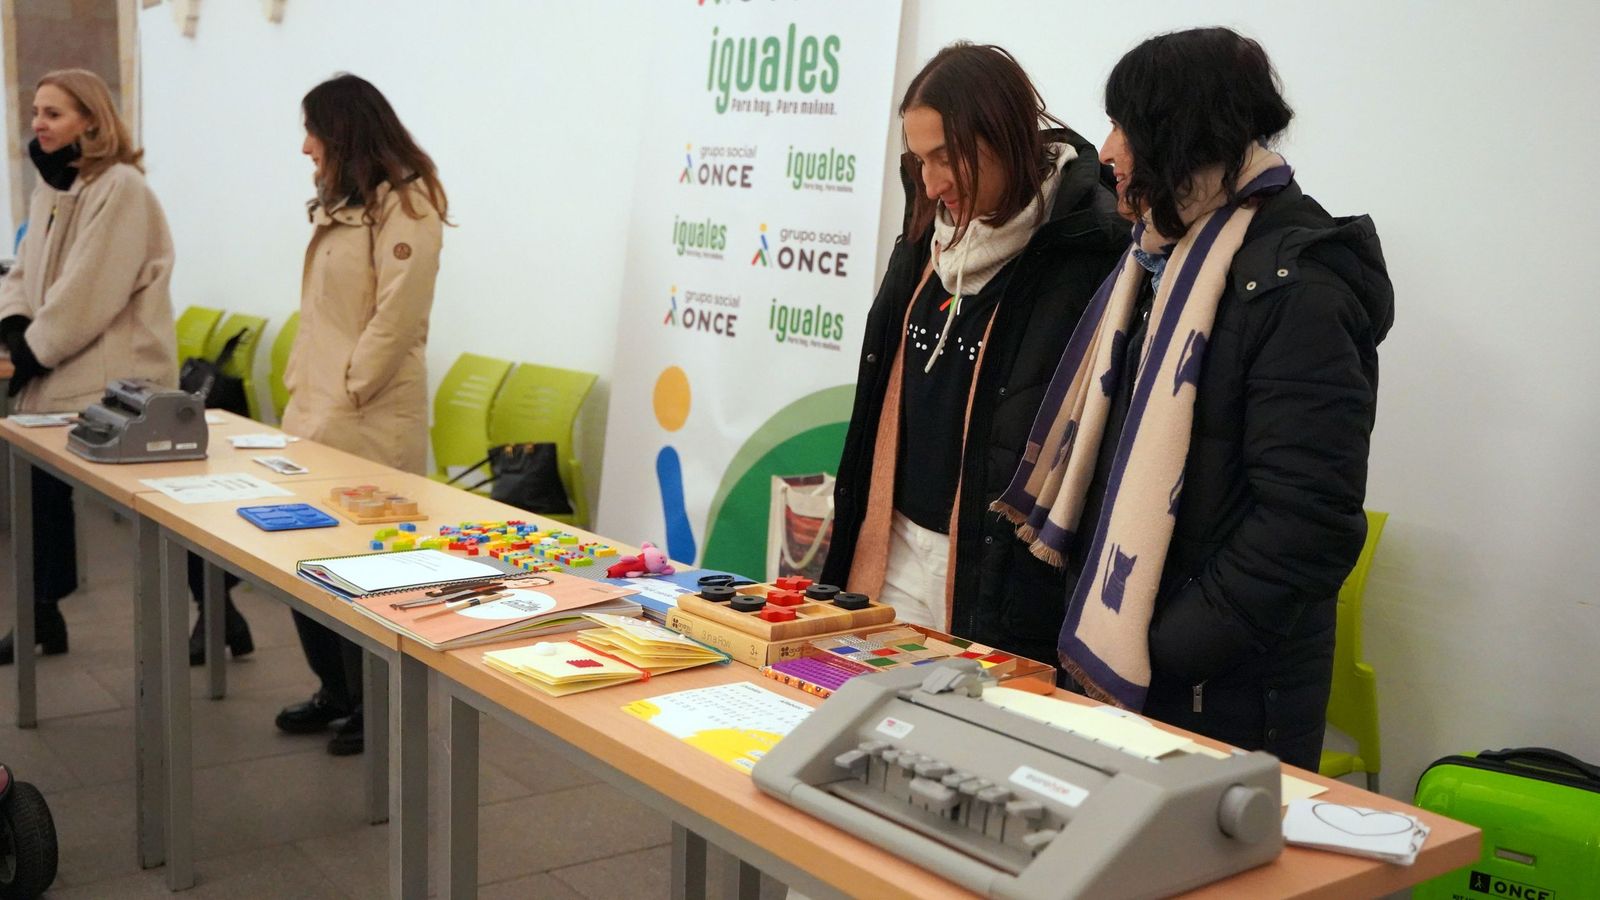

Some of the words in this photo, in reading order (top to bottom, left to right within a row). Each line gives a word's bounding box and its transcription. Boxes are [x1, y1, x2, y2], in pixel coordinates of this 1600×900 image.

[707, 22, 841, 115] iguales
[731, 97, 751, 112] Para
[776, 97, 798, 114] Para
[700, 145, 725, 160] grupo
[726, 145, 758, 159] social
[698, 163, 754, 189] ONCE
[786, 145, 857, 190] iguales
[672, 214, 728, 256] iguales
[780, 227, 817, 243] grupo
[818, 230, 852, 246] social
[777, 246, 849, 277] ONCE
[685, 290, 713, 306] grupo
[713, 293, 741, 308] social
[682, 307, 738, 338] ONCE
[769, 298, 845, 342] iguales
[750, 644, 758, 656] 3+
[1494, 881, 1550, 900] ONCE
